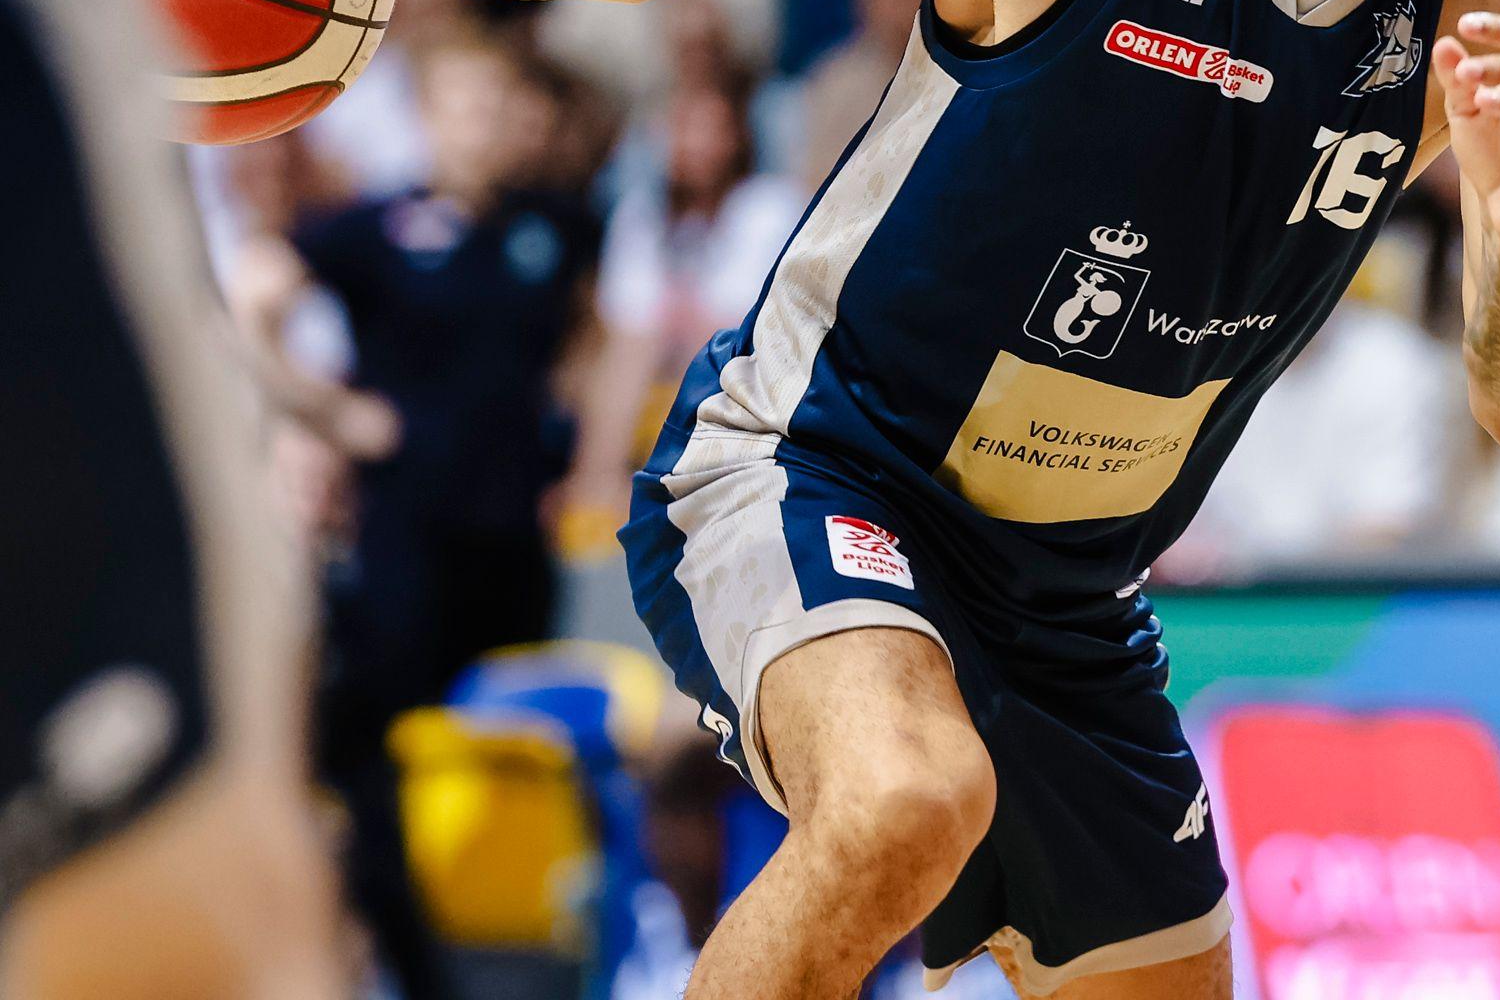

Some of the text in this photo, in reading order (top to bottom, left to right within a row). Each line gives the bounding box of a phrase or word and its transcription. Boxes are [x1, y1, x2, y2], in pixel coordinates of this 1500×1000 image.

[1115, 30, 1196, 69] ORLEN
[1227, 64, 1265, 85] Bsket
[1286, 125, 1406, 230] 16
[1147, 308, 1277, 345] Warzawa
[972, 436, 1091, 470] FINANCIAL
